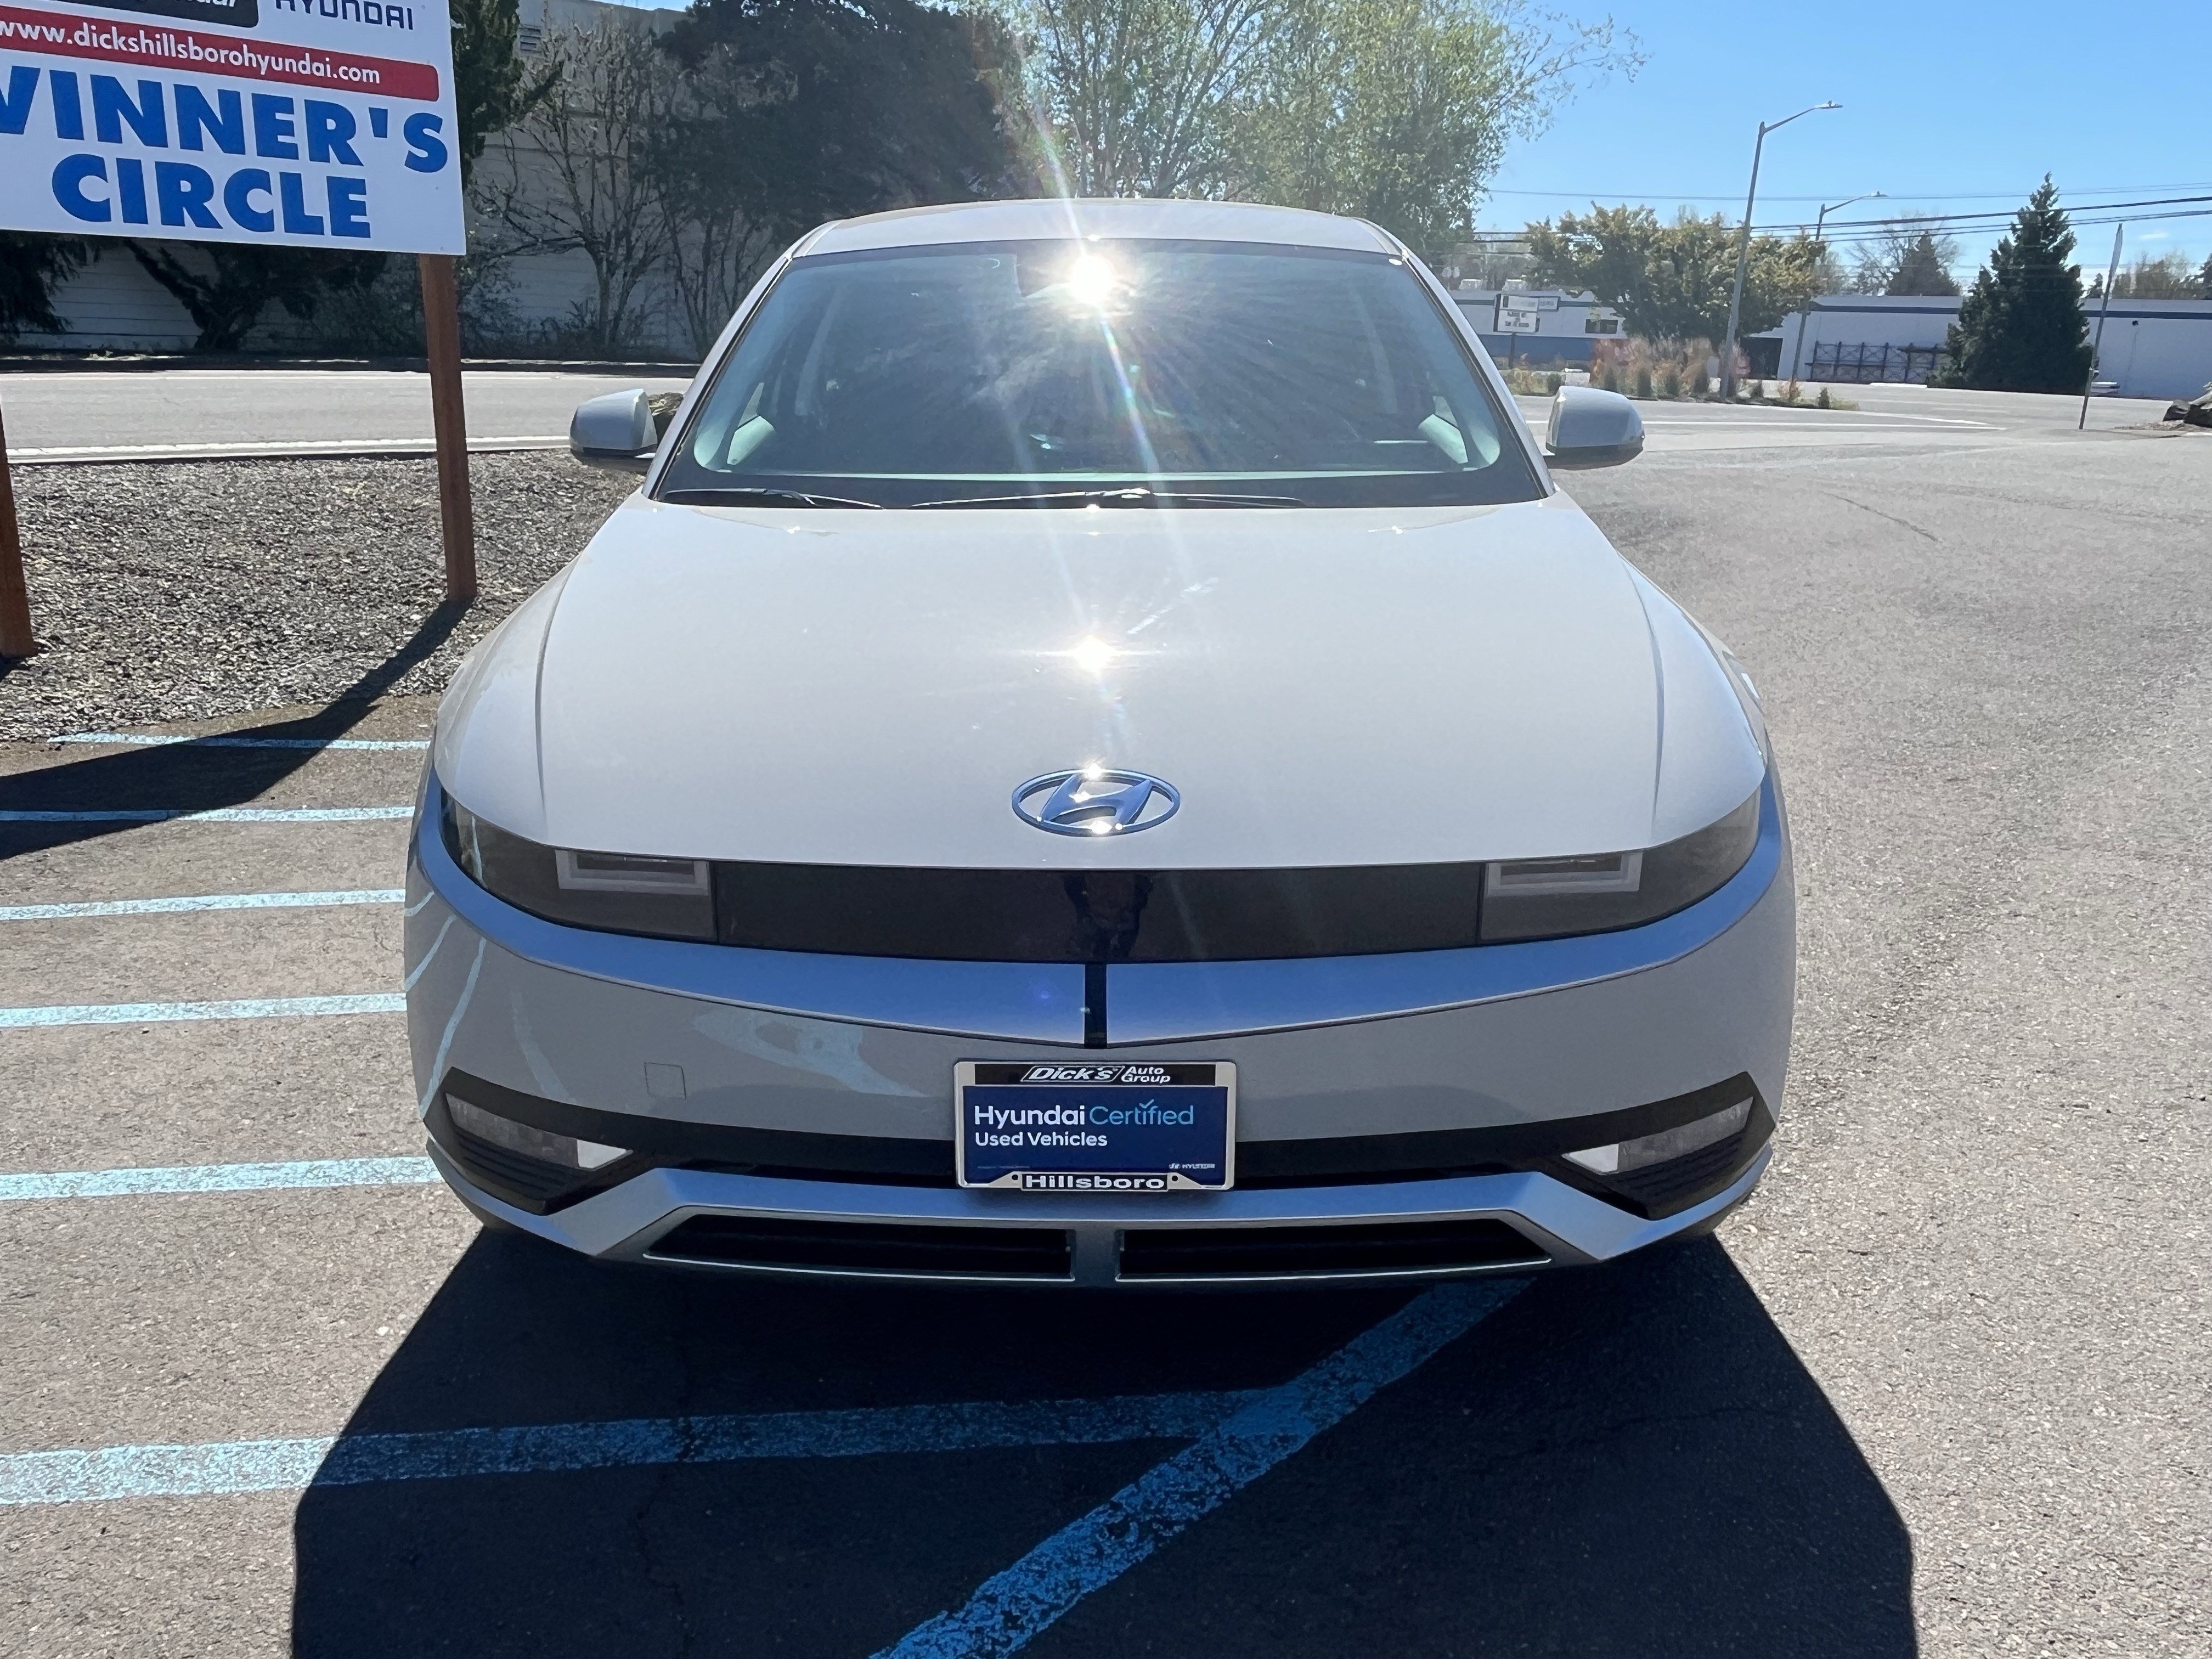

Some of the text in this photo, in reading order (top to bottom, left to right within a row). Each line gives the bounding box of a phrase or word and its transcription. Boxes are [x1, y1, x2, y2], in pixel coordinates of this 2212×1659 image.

[0, 20, 380, 84] www.dickshillsborohyundai.com
[52, 154, 371, 238] CIRCLE
[1028, 1067, 1114, 1080] Dick's
[1127, 1066, 1164, 1075] Auto
[1121, 1074, 1171, 1084] Group
[974, 1099, 1194, 1129] Hyundai Certified
[975, 1131, 1108, 1147] Used Vehicles
[1026, 1175, 1165, 1189] Hillsboro
